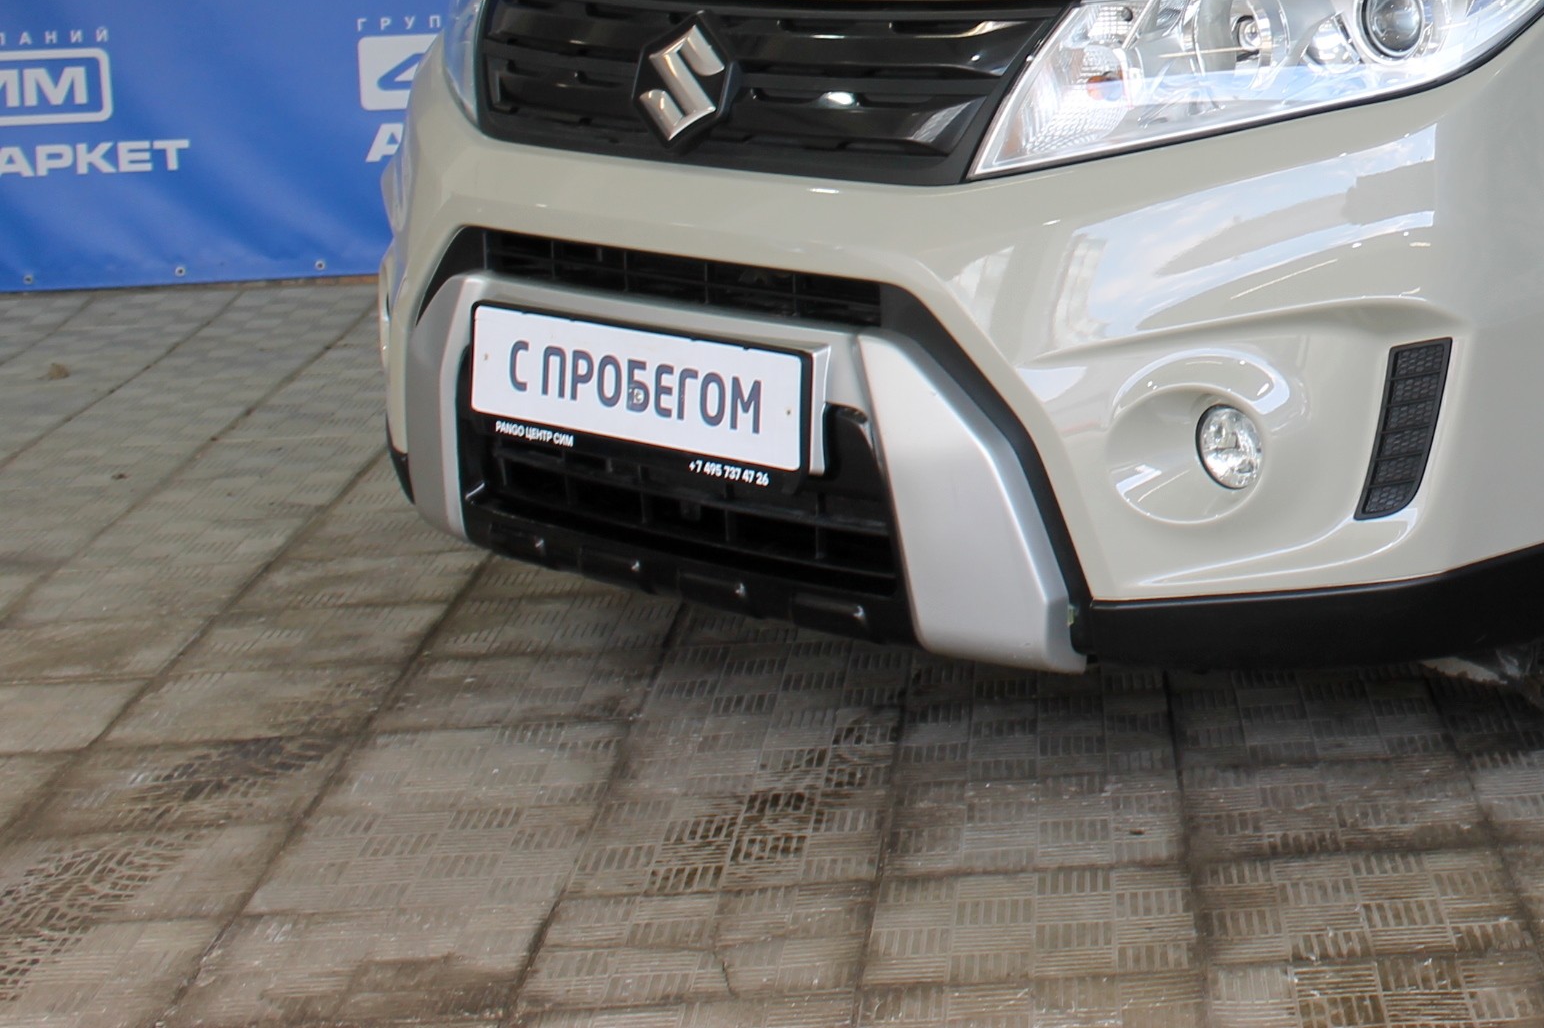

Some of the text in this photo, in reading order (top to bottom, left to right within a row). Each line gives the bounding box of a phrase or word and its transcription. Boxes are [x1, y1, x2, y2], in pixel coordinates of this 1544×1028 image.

[541, 345, 762, 434] ПРОБЕГОМ
[525, 425, 553, 443] ЦЕНТР
[553, 431, 575, 448] СИМ
[688, 459, 769, 486] +7 495 737 47 26
